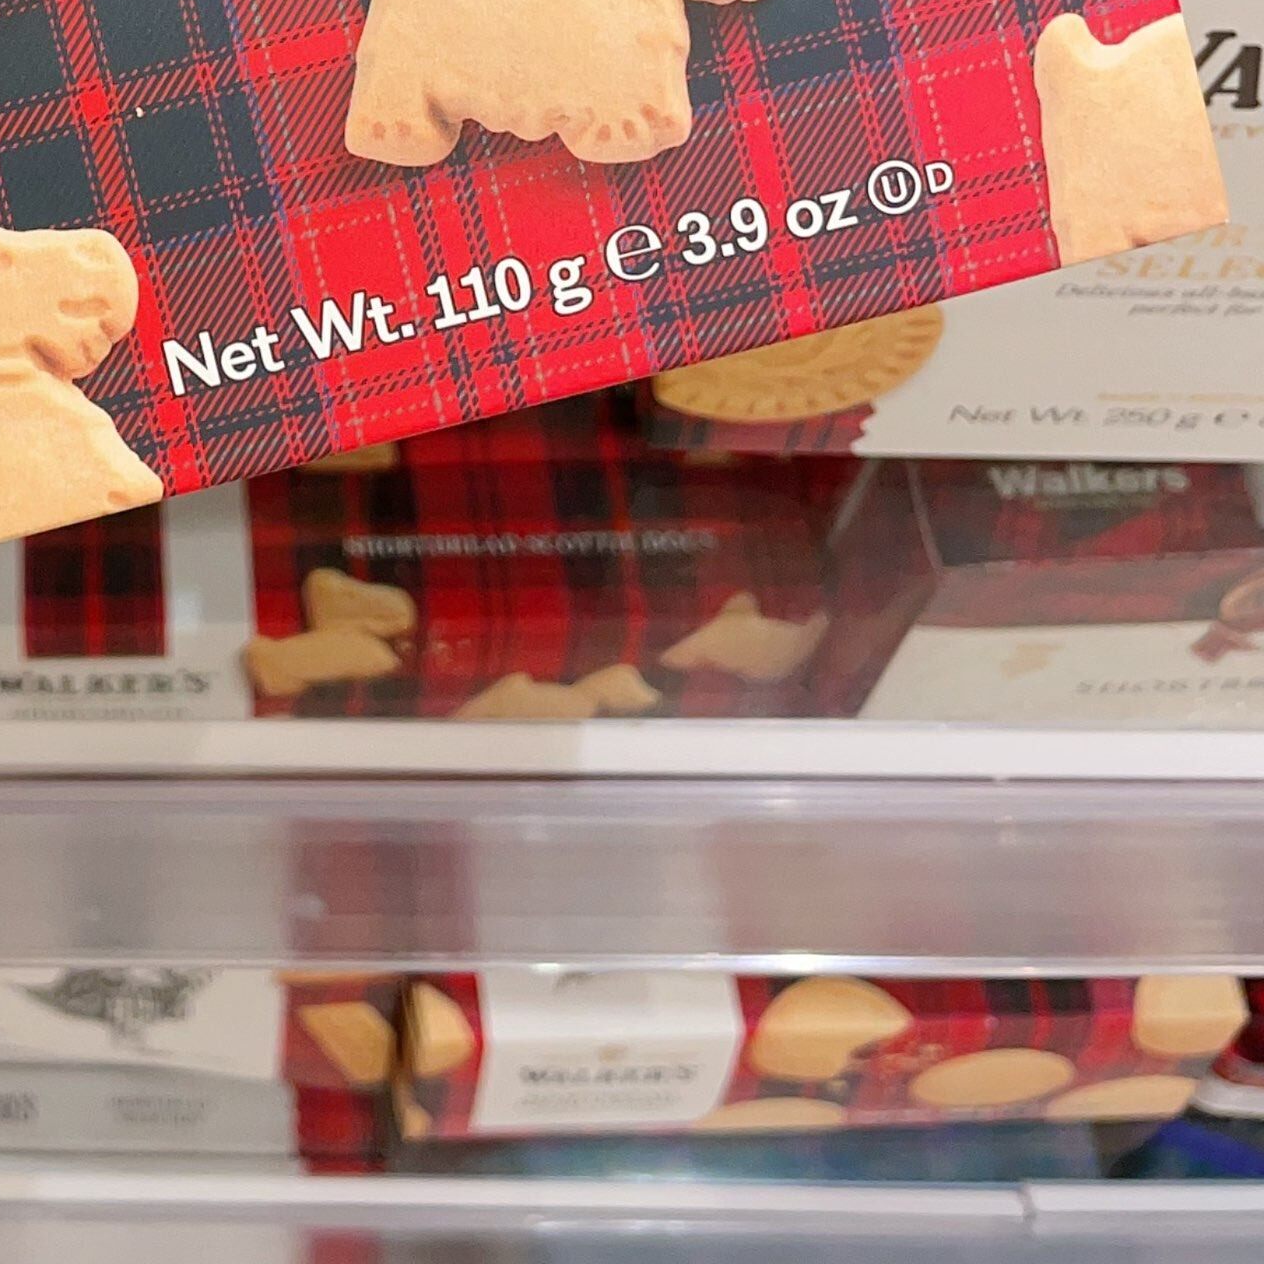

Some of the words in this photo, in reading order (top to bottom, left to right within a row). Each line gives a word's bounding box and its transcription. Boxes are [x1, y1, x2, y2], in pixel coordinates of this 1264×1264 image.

[162, 331, 286, 397] Net
[291, 290, 415, 361] Wt.
[427, 255, 532, 331] 110
[551, 255, 589, 315] g
[677, 198, 768, 268] 3.9
[786, 185, 859, 242] oz
[987, 461, 1191, 500] Walkers
